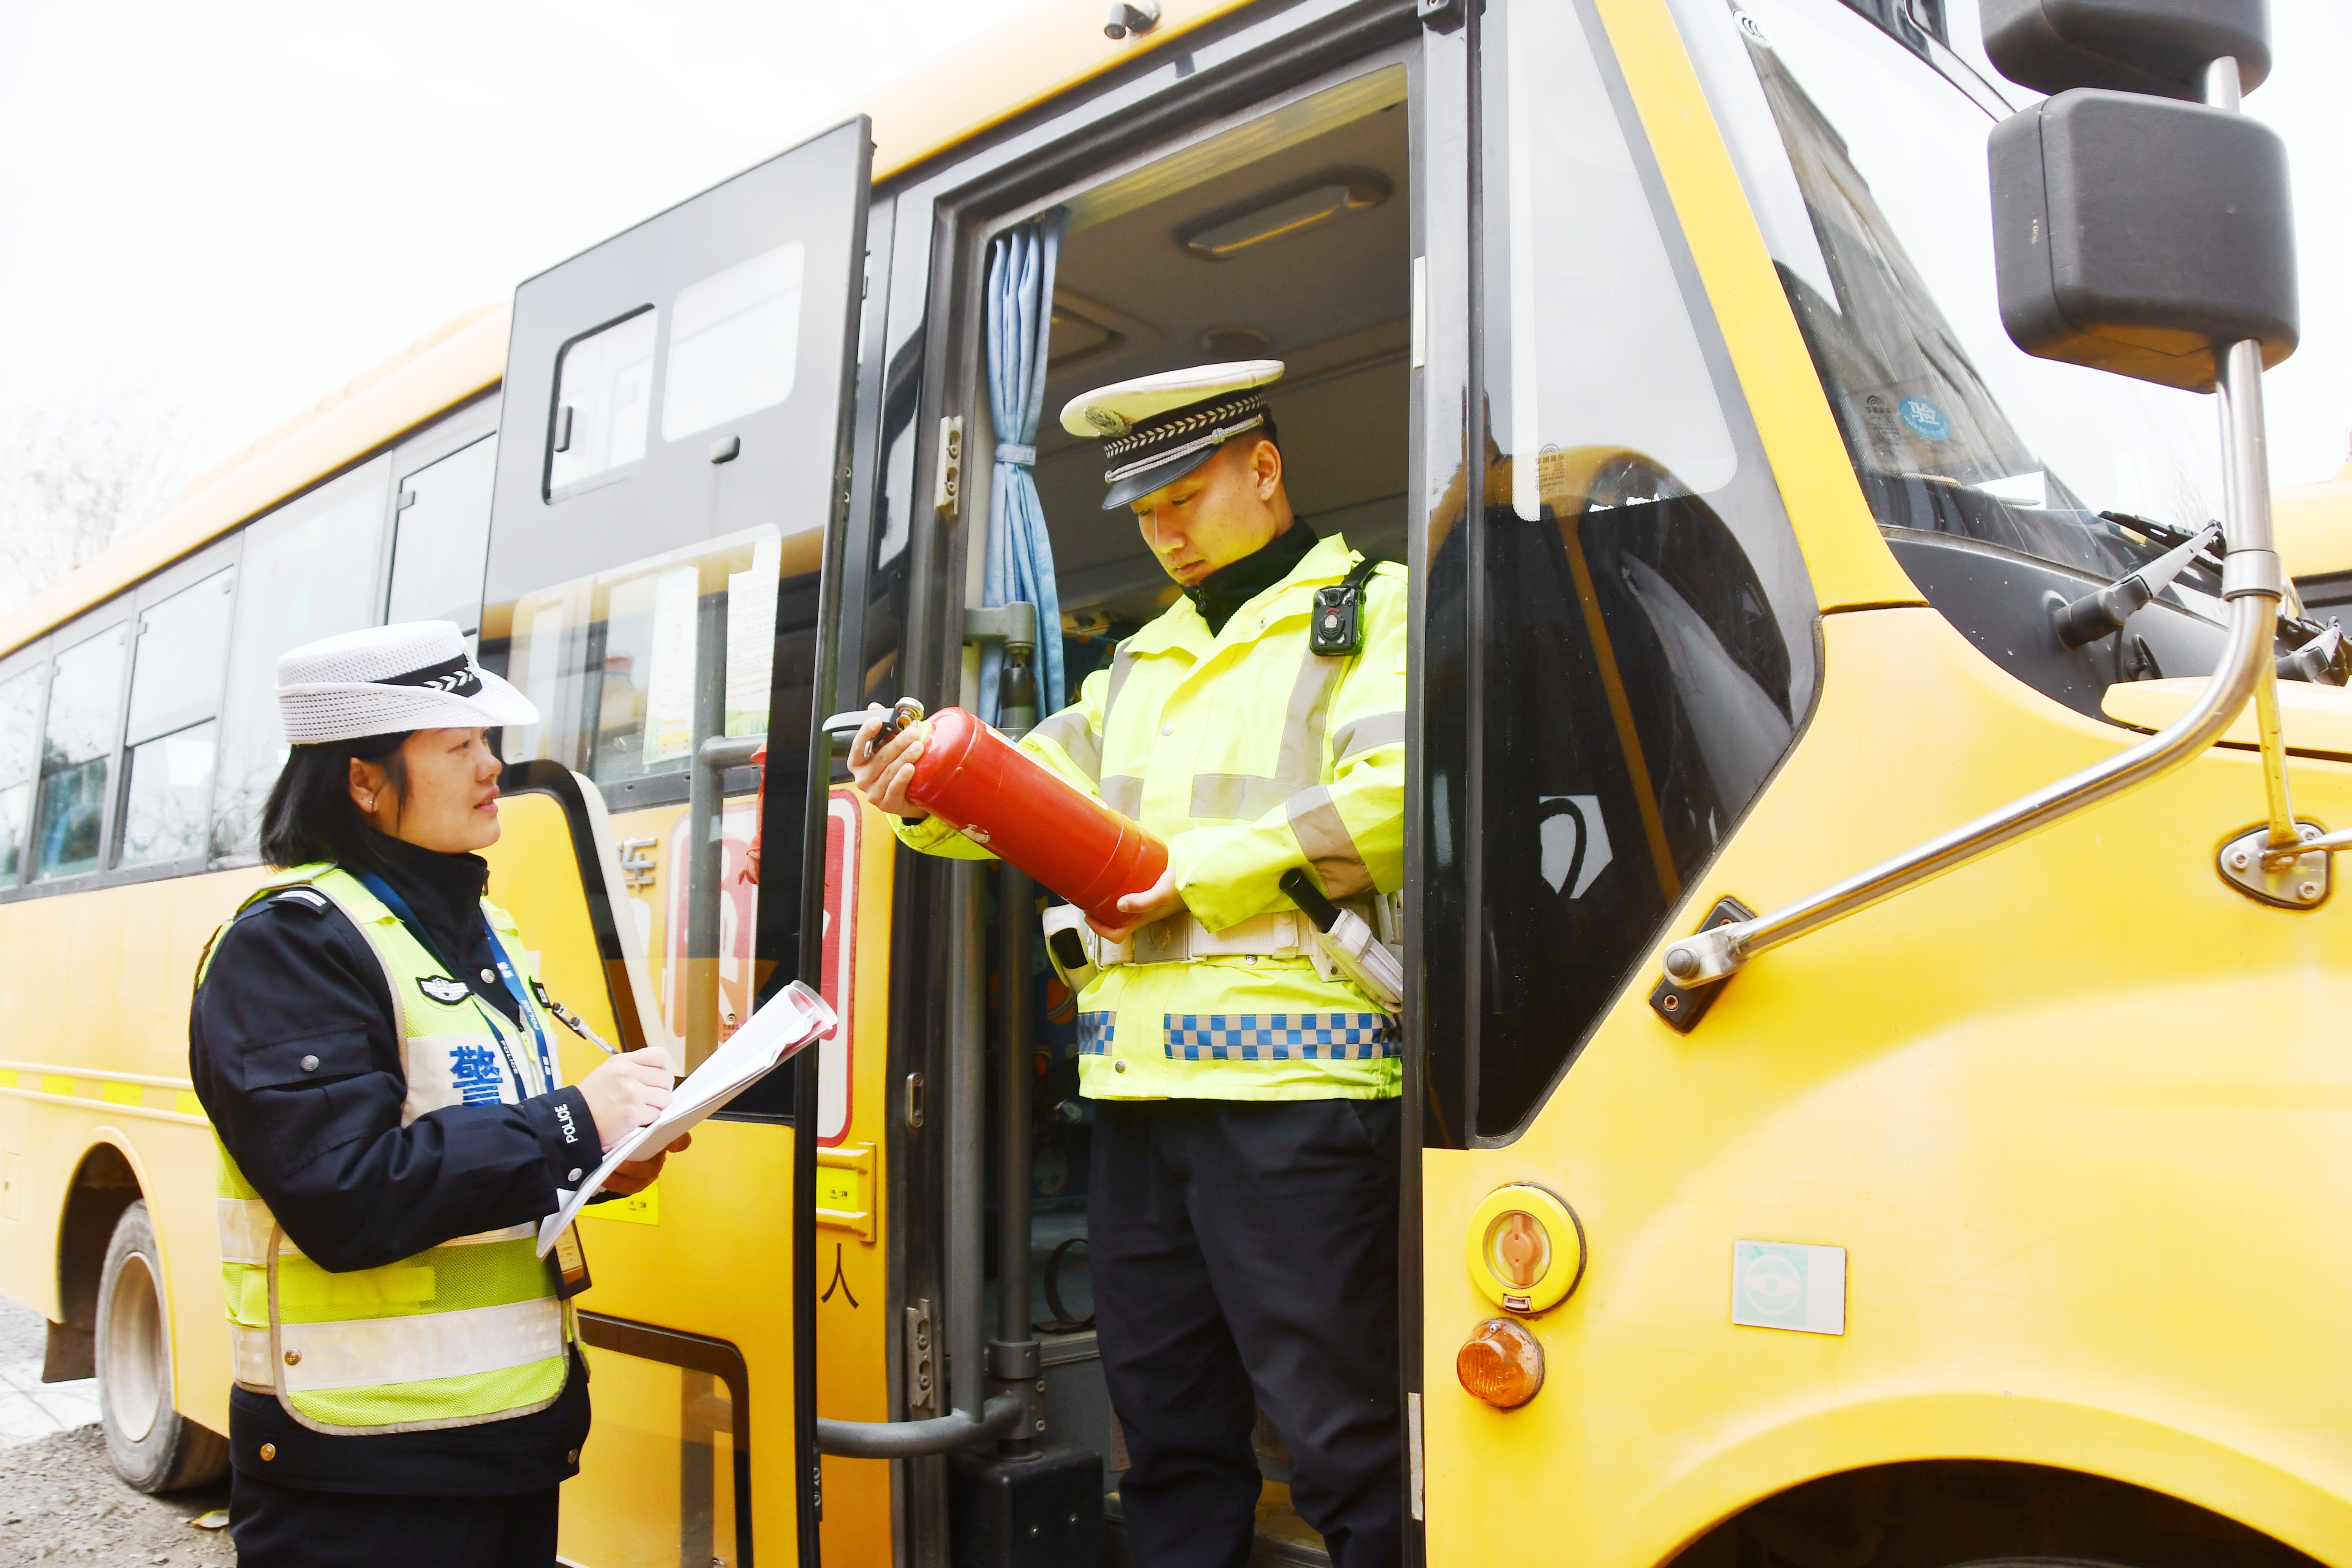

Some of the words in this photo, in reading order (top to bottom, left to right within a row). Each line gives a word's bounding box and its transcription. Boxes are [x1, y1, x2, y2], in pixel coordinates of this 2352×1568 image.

[1908, 401, 1940, 426] 验
[615, 838, 657, 893] 车
[520, 999, 540, 1030] POLICE
[500, 1040, 519, 1074] POLICE
[554, 1103, 579, 1144] POLICE
[820, 1243, 859, 1309] 人
